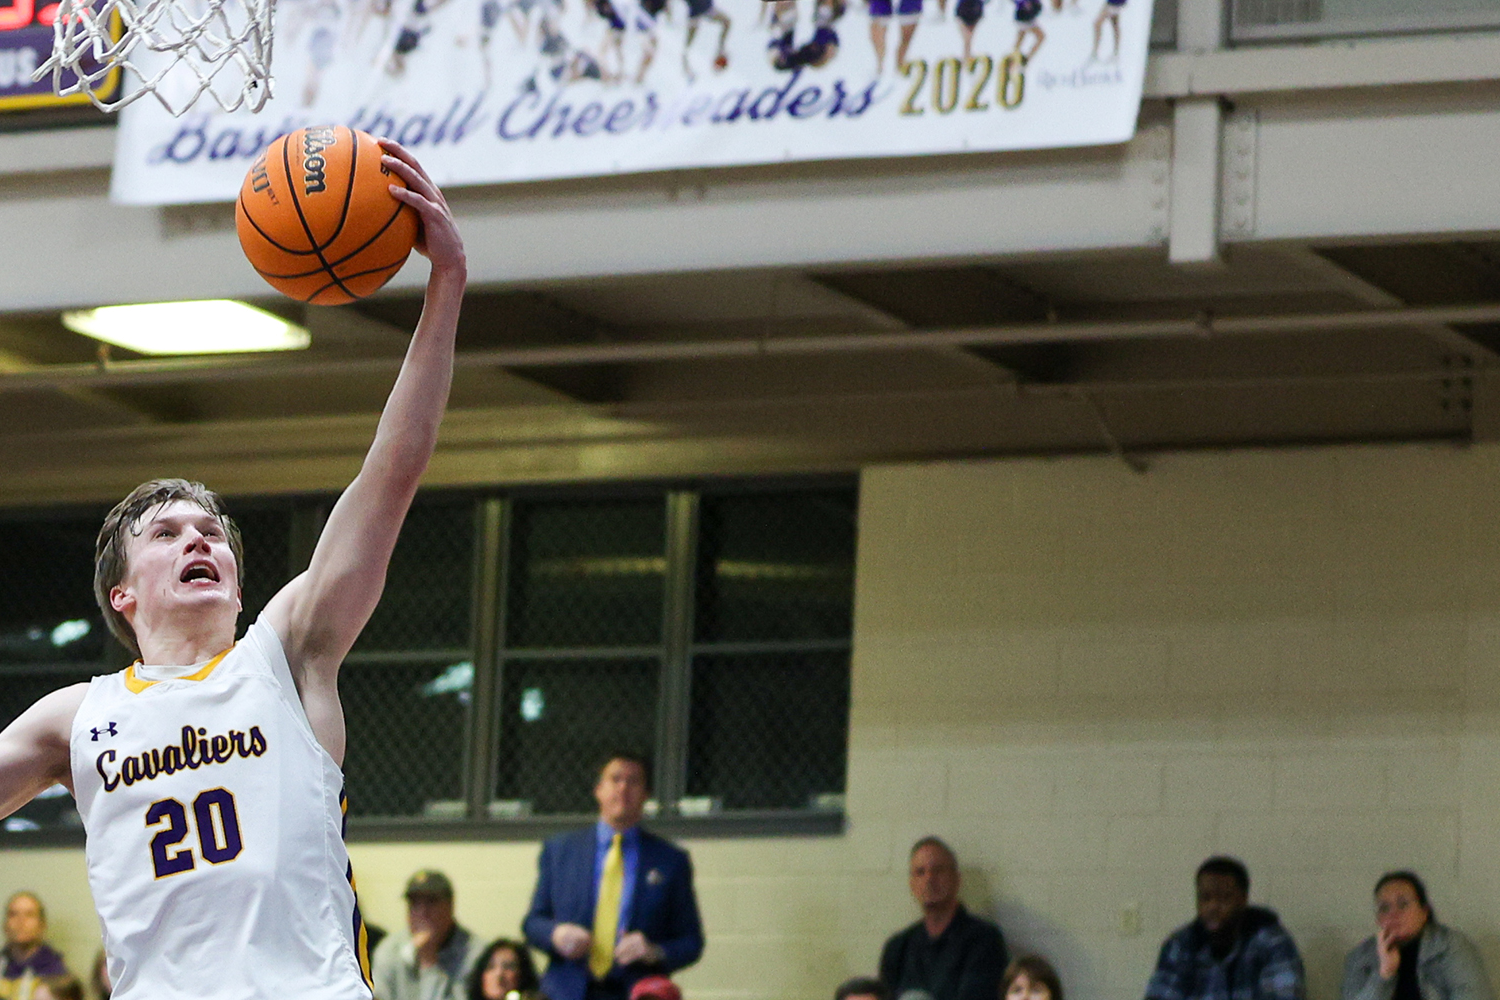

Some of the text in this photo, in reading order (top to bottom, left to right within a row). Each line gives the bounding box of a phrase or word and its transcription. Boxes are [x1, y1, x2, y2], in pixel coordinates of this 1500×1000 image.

[150, 90, 484, 163] Bastball
[898, 52, 1027, 117] 2026
[96, 725, 268, 793] Cavaliers
[145, 786, 245, 881] 20
